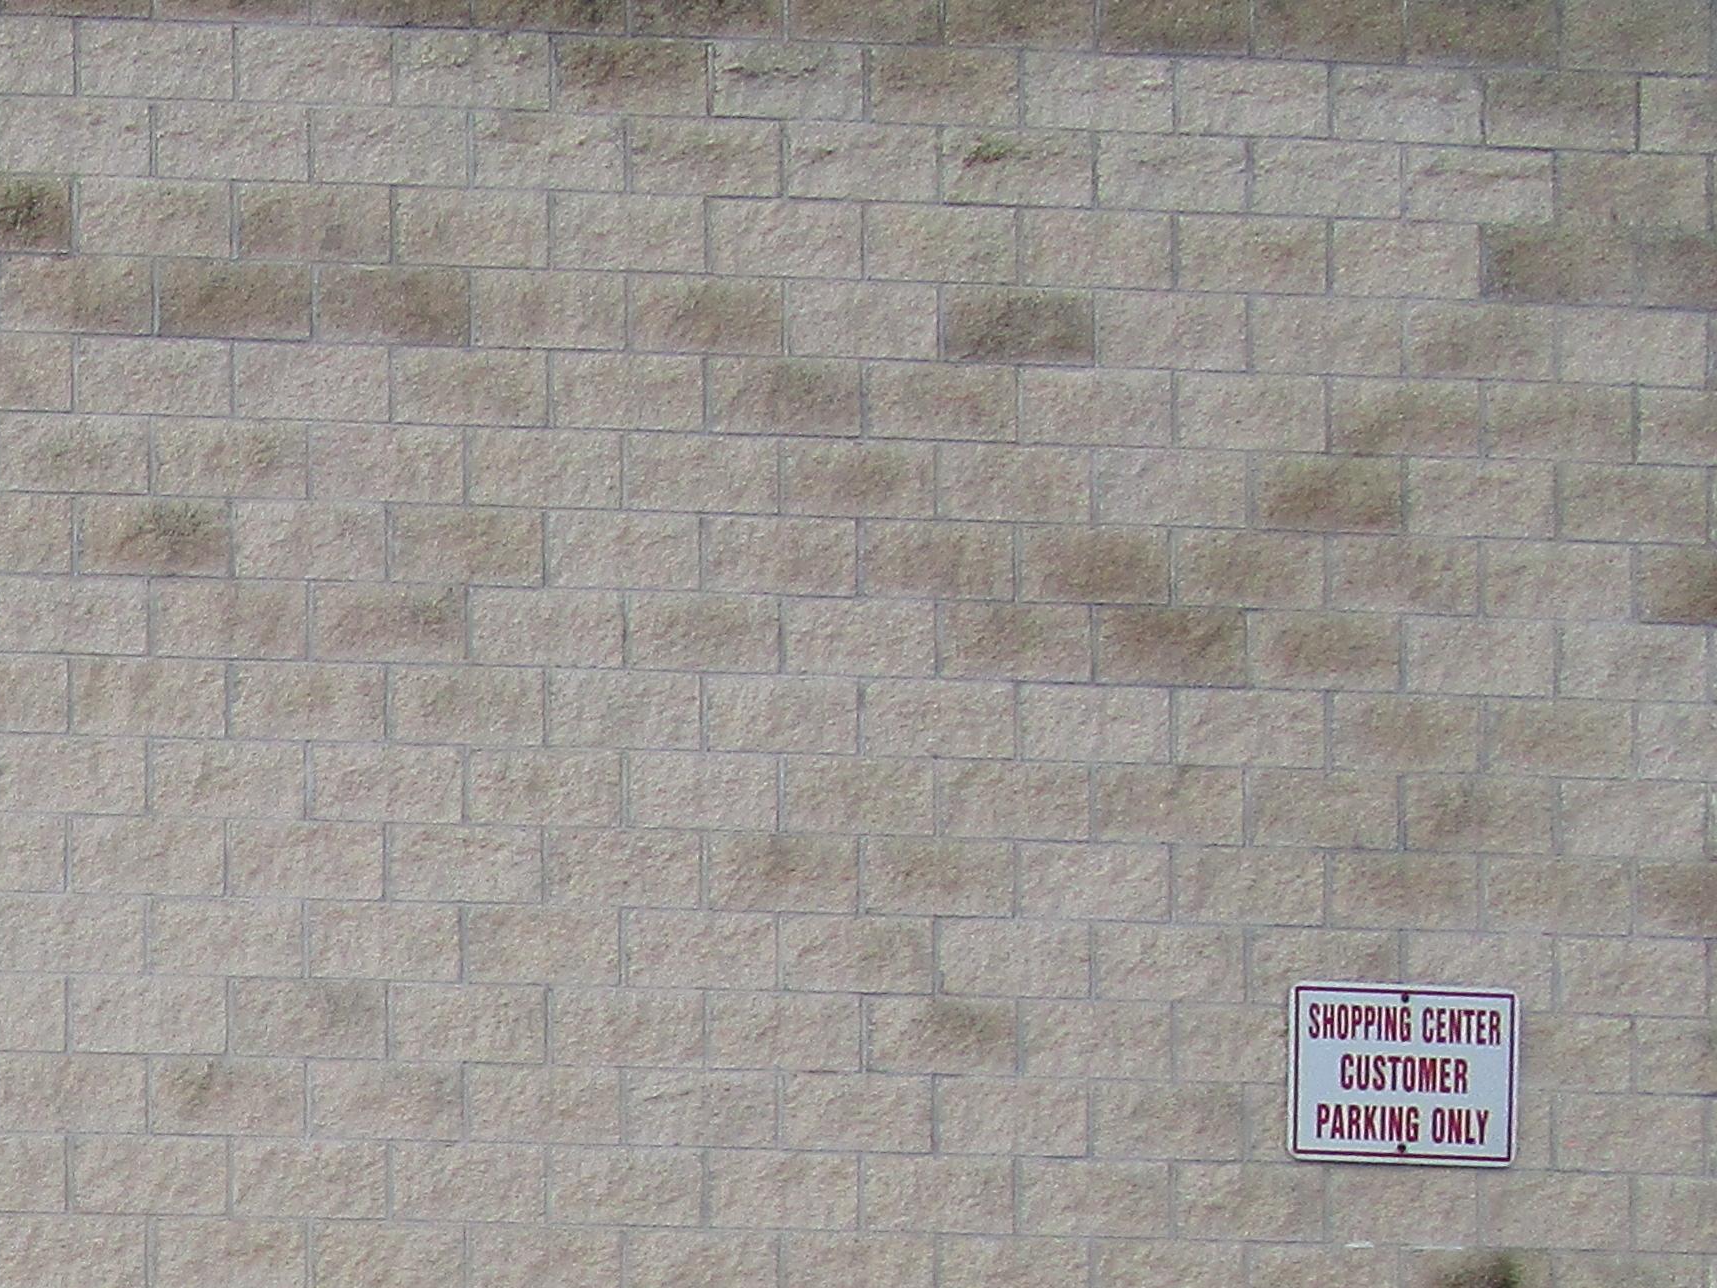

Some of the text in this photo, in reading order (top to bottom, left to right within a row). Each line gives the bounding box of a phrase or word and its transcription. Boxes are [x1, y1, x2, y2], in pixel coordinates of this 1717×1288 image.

[1308, 1003, 1501, 1045] SHOPPING CENTER
[1340, 1053, 1468, 1094] CUSTOMER
[1316, 1103, 1489, 1145] PARKING ONLY
